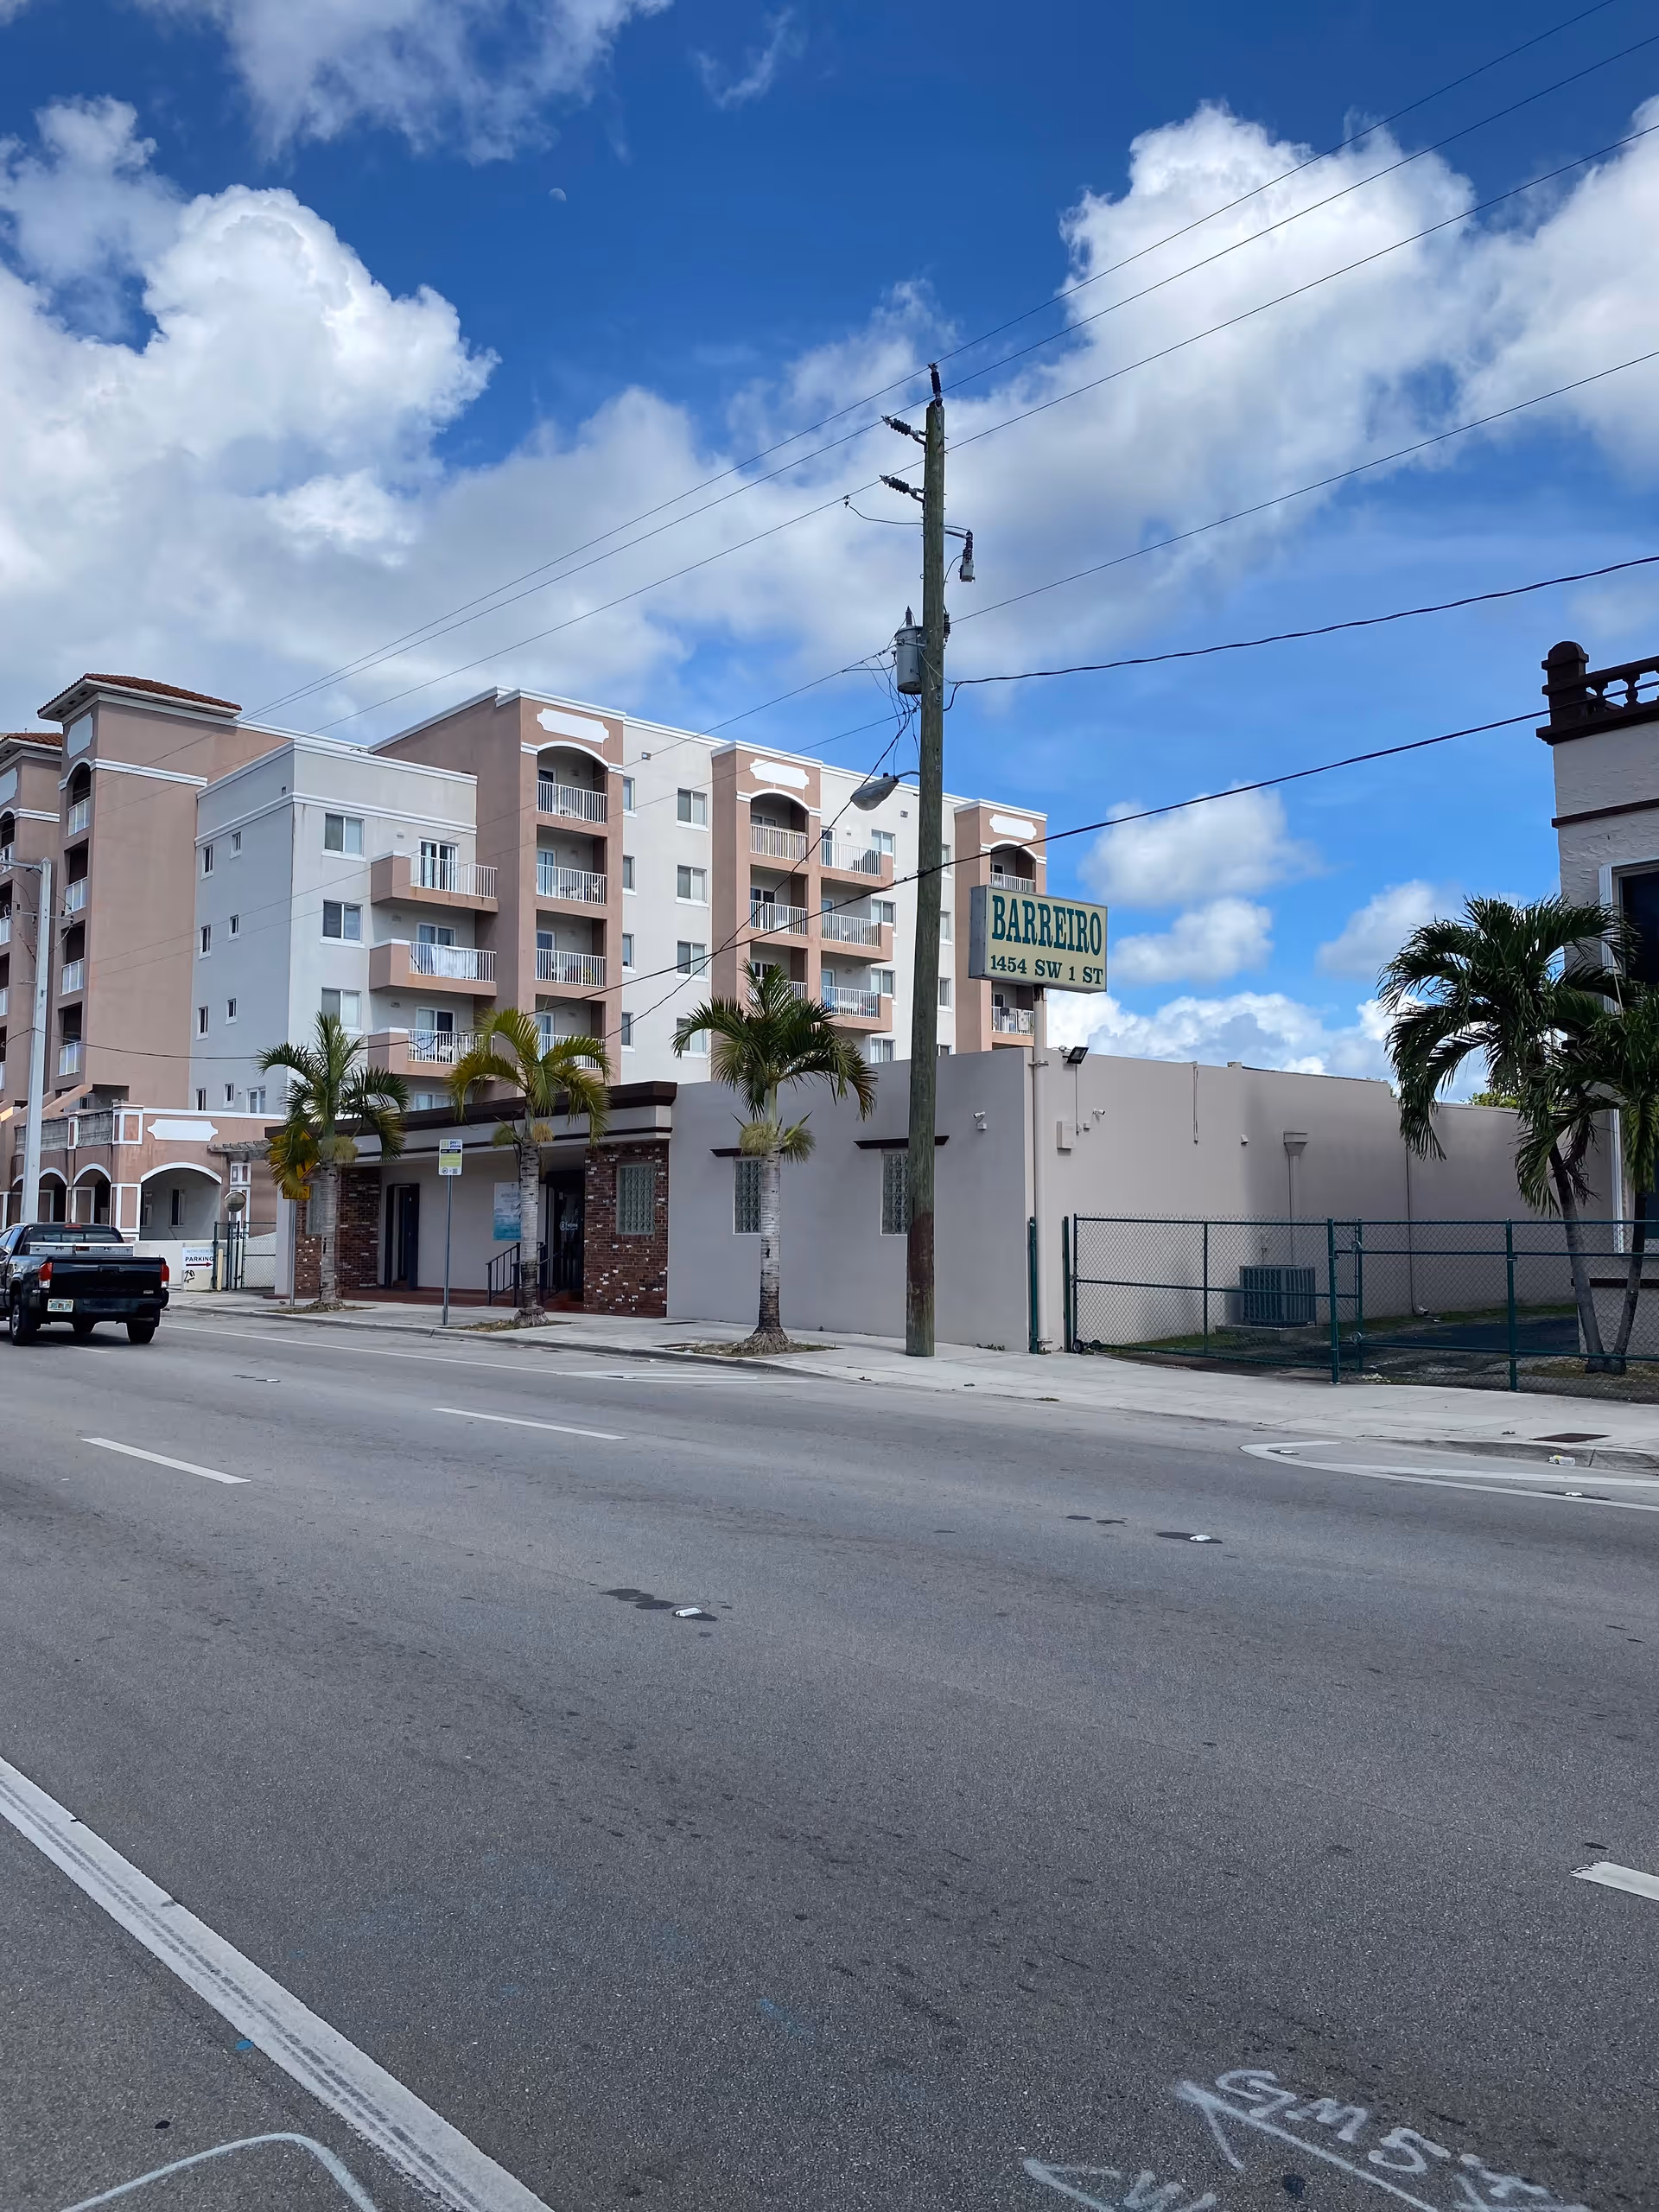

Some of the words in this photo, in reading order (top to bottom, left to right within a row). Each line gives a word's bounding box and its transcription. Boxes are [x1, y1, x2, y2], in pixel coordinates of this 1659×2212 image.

[992, 894, 1102, 956] BARREIRO
[990, 954, 1027, 975] 1454
[1034, 959, 1063, 979] SW
[1068, 966, 1076, 982] 1
[1082, 966, 1103, 985] ST
